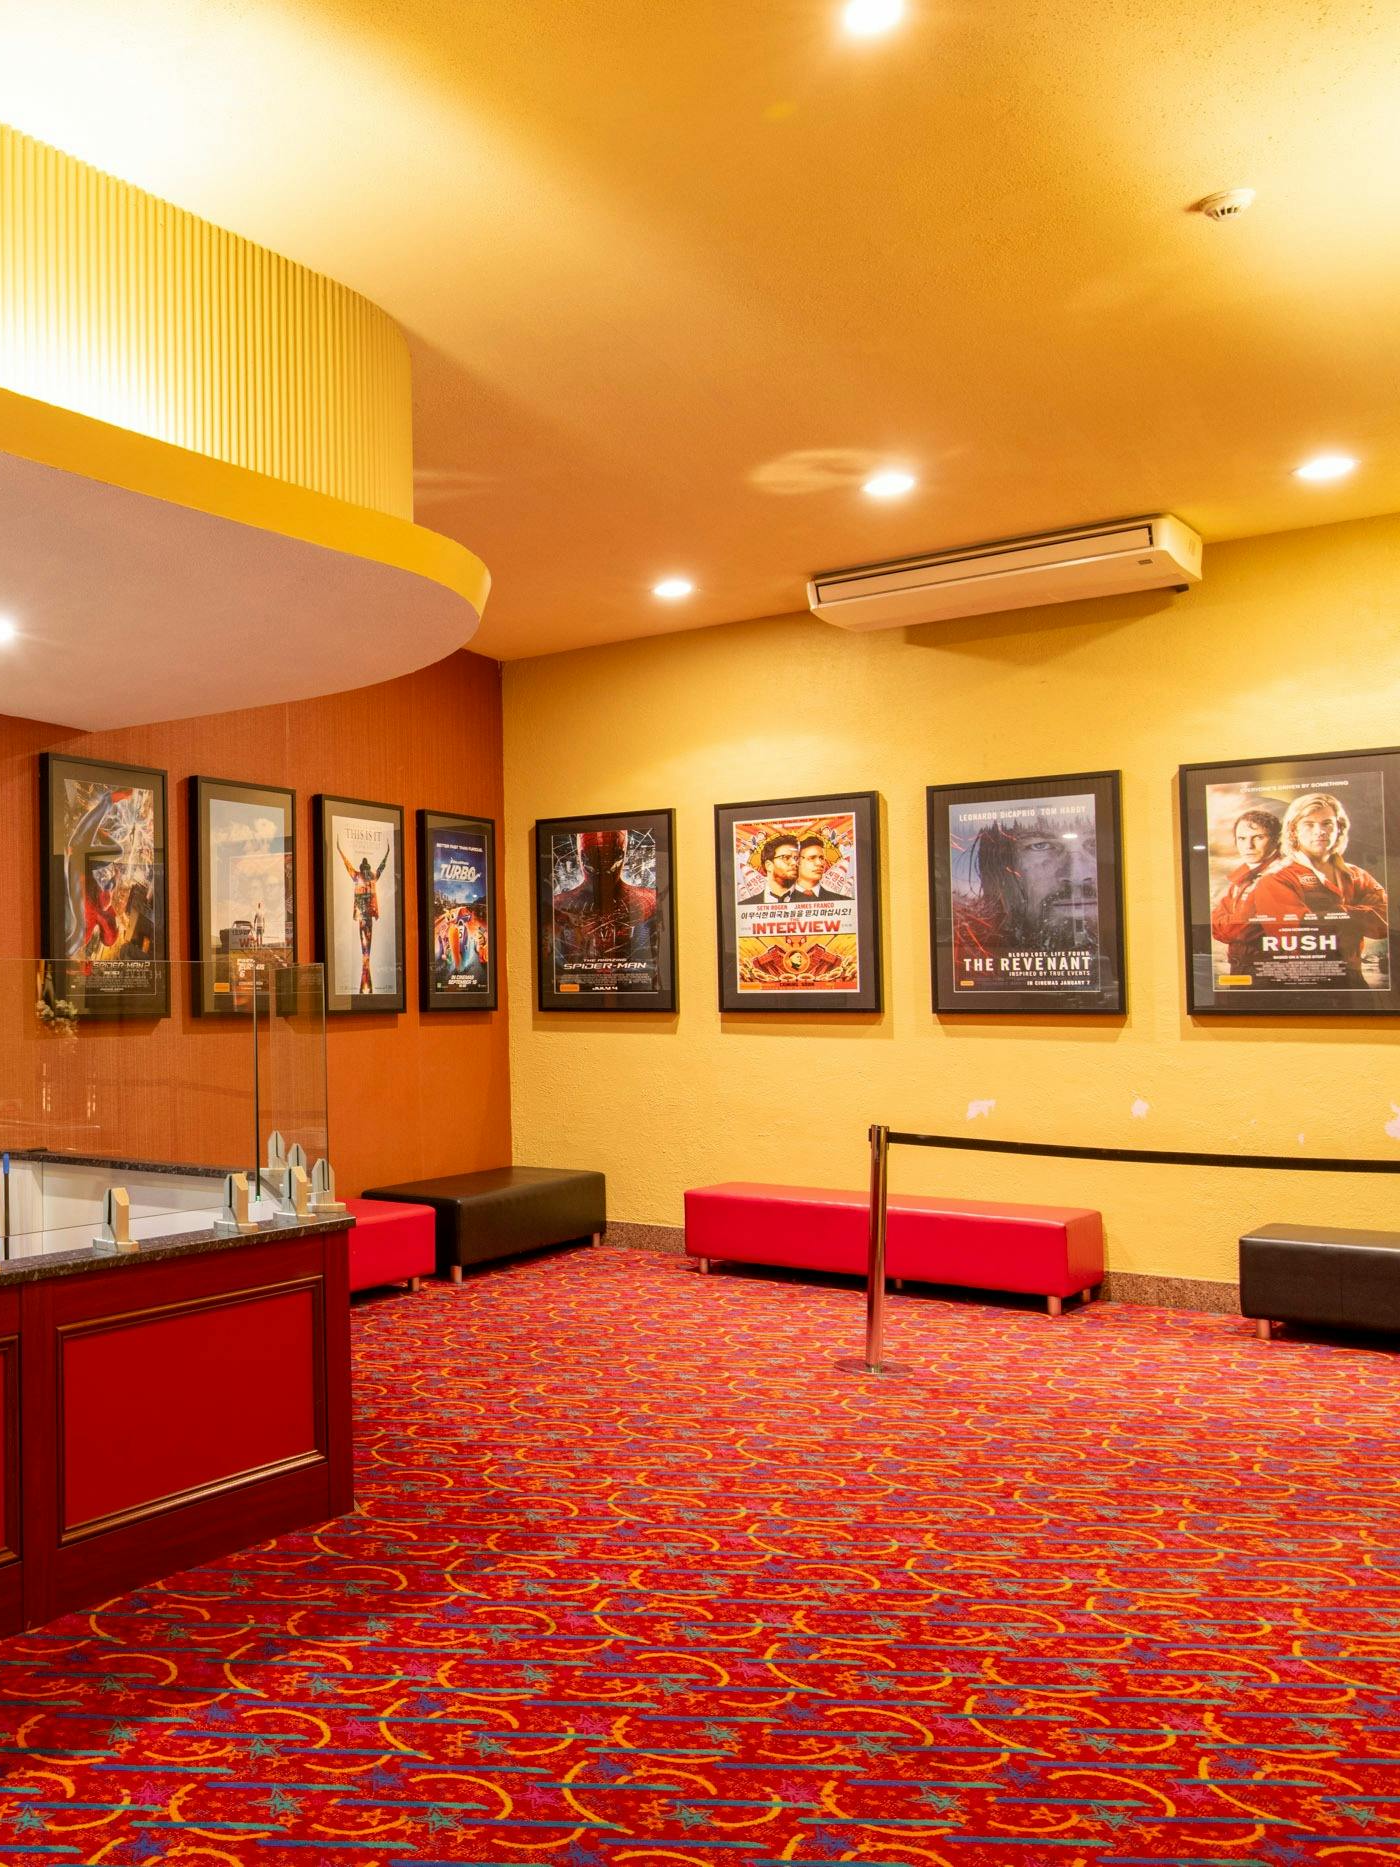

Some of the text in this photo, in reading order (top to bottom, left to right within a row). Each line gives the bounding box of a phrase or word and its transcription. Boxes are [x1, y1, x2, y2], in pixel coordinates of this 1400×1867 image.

[959, 811, 997, 822] LEONARDO
[1041, 807, 1057, 816] TOM
[1060, 805, 1087, 815] HARDY
[344, 828, 365, 840] THIS
[365, 830, 373, 841] IS
[440, 863, 476, 881] TURBO
[752, 920, 841, 935] INTERVIEW
[1262, 934, 1337, 951] RUSH
[563, 962, 648, 970] SPIDER-MAN
[963, 957, 1092, 971] THE REVENANT
